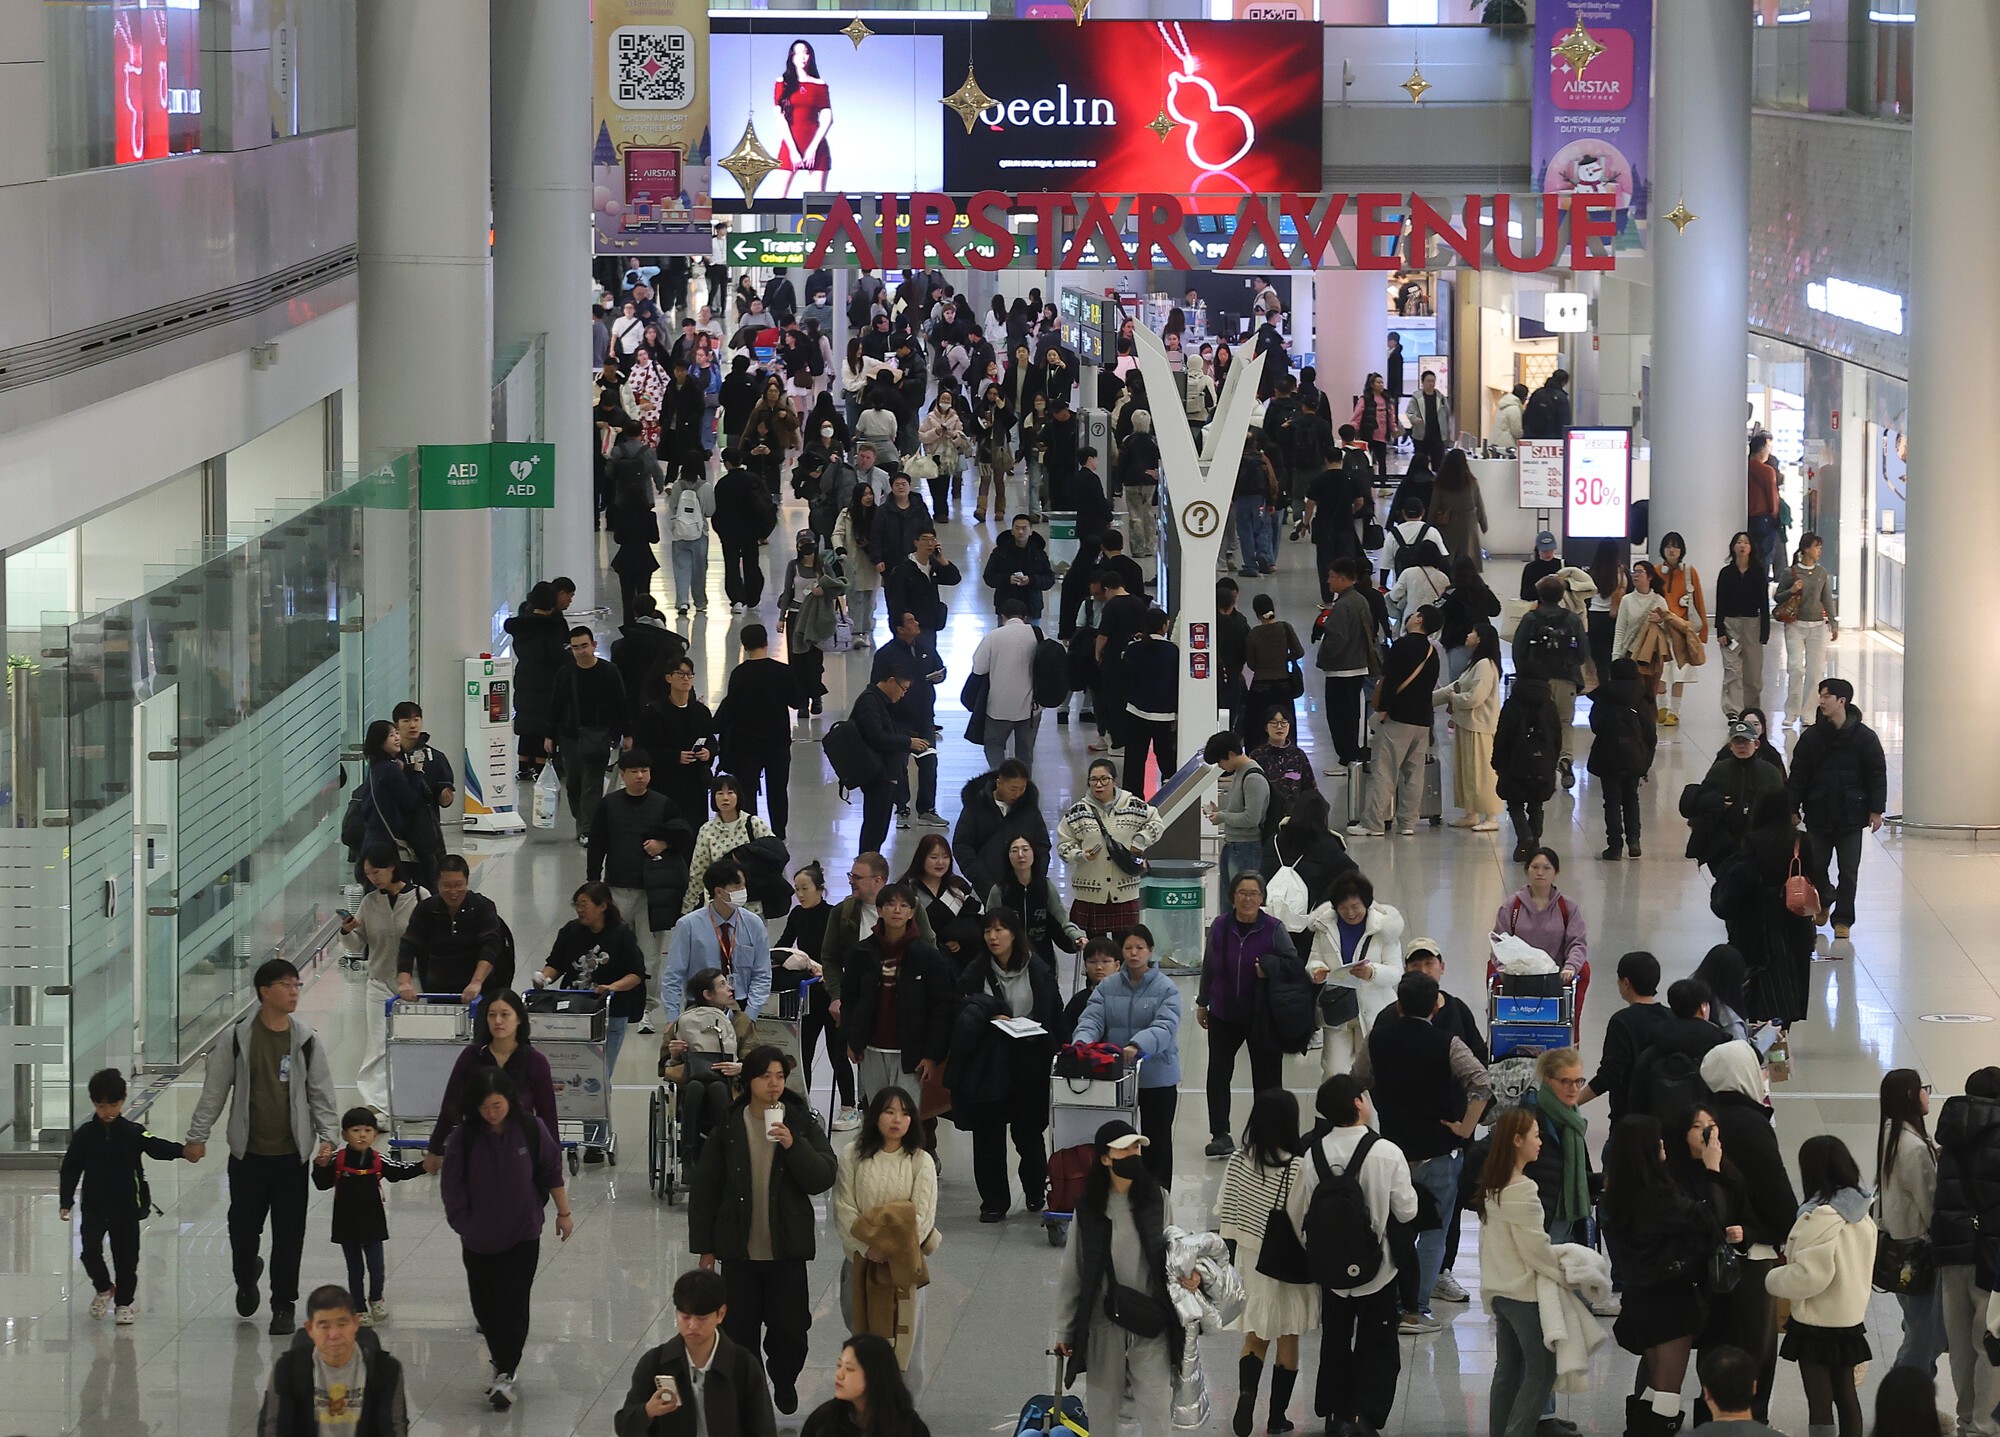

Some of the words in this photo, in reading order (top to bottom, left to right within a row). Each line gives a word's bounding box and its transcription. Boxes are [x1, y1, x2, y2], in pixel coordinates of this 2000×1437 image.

[1563, 81, 1620, 93] AIRSTAR
[643, 169, 677, 177] AIRSTAR
[803, 190, 1192, 271] AIRSTAR
[1216, 190, 1617, 272] AVENUE
[760, 254, 786, 263] Other
[1532, 446, 1564, 458] SALE
[447, 463, 478, 478] AED
[506, 484, 536, 496] AED
[1575, 477, 1620, 506] 30%
[492, 682, 506, 692] AED
